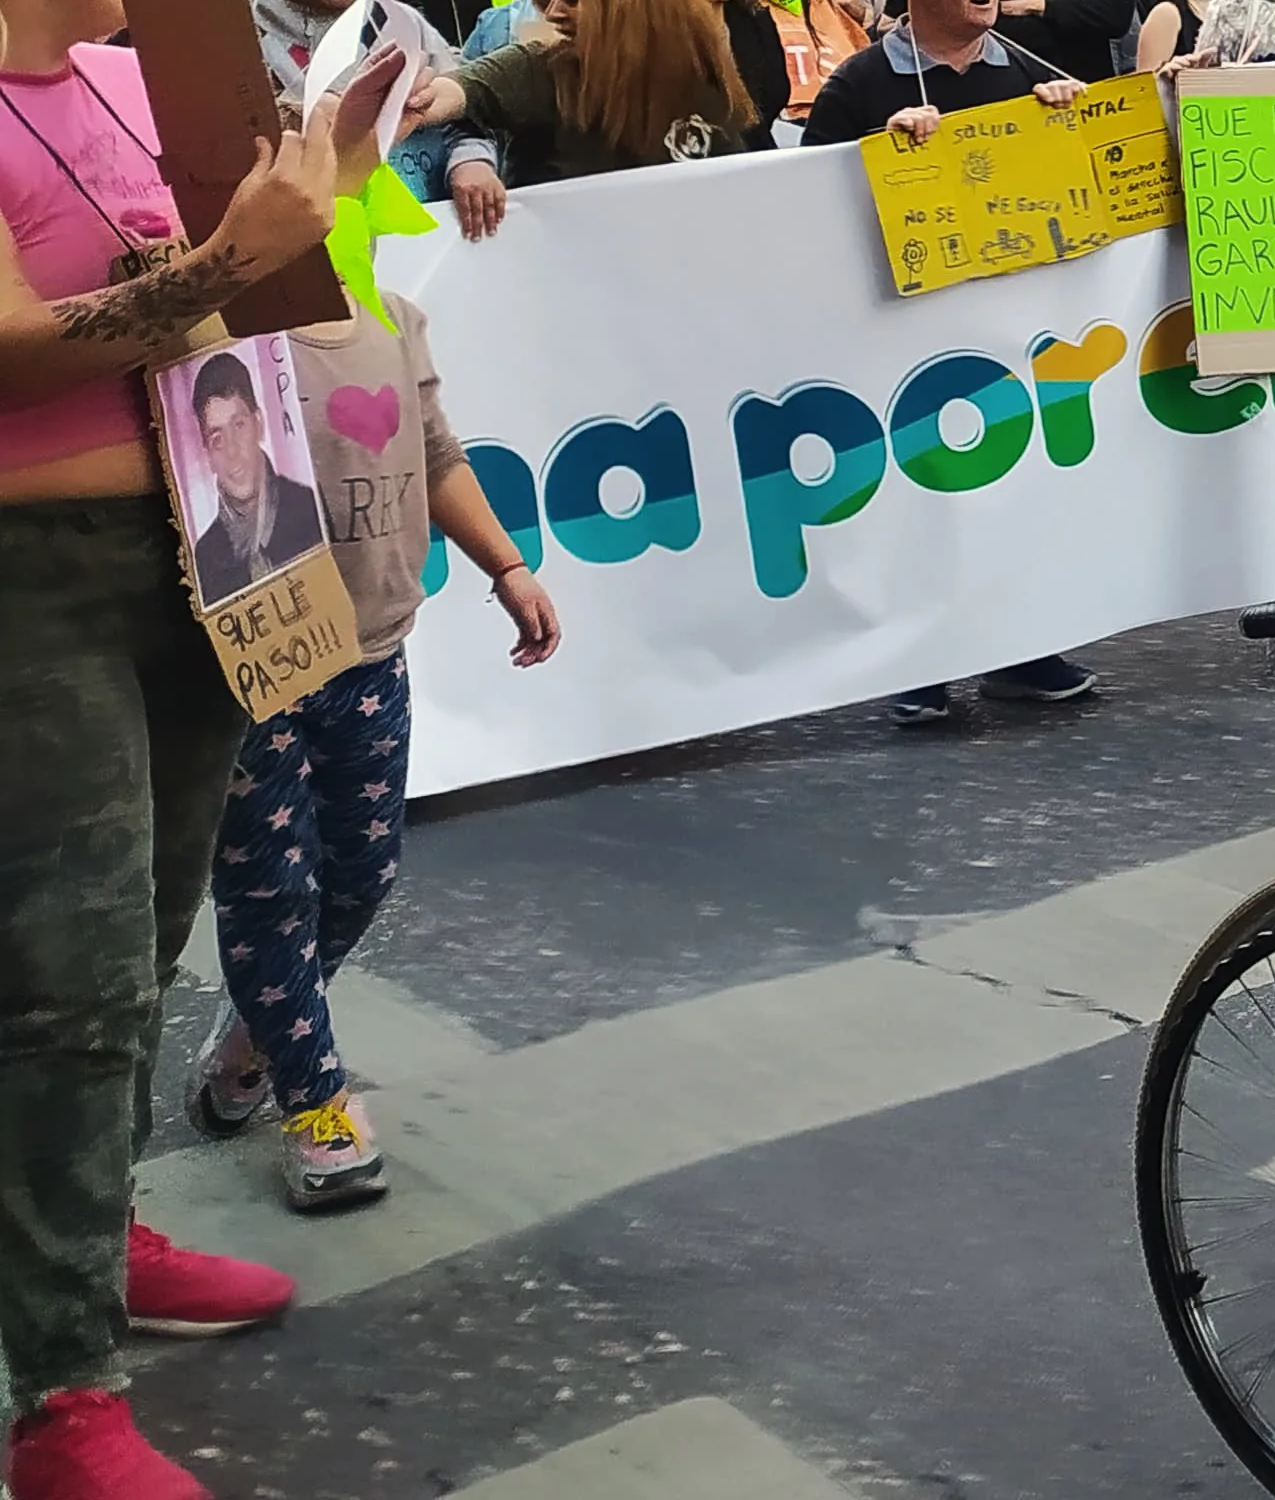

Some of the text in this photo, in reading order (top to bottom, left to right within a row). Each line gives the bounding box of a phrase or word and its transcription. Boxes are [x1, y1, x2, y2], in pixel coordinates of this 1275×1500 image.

[1183, 104, 1251, 140] QUE
[905, 209, 926, 226] NO
[936, 207, 956, 223] SE
[727, 316, 1128, 599] por
[217, 601, 271, 652] QUE
